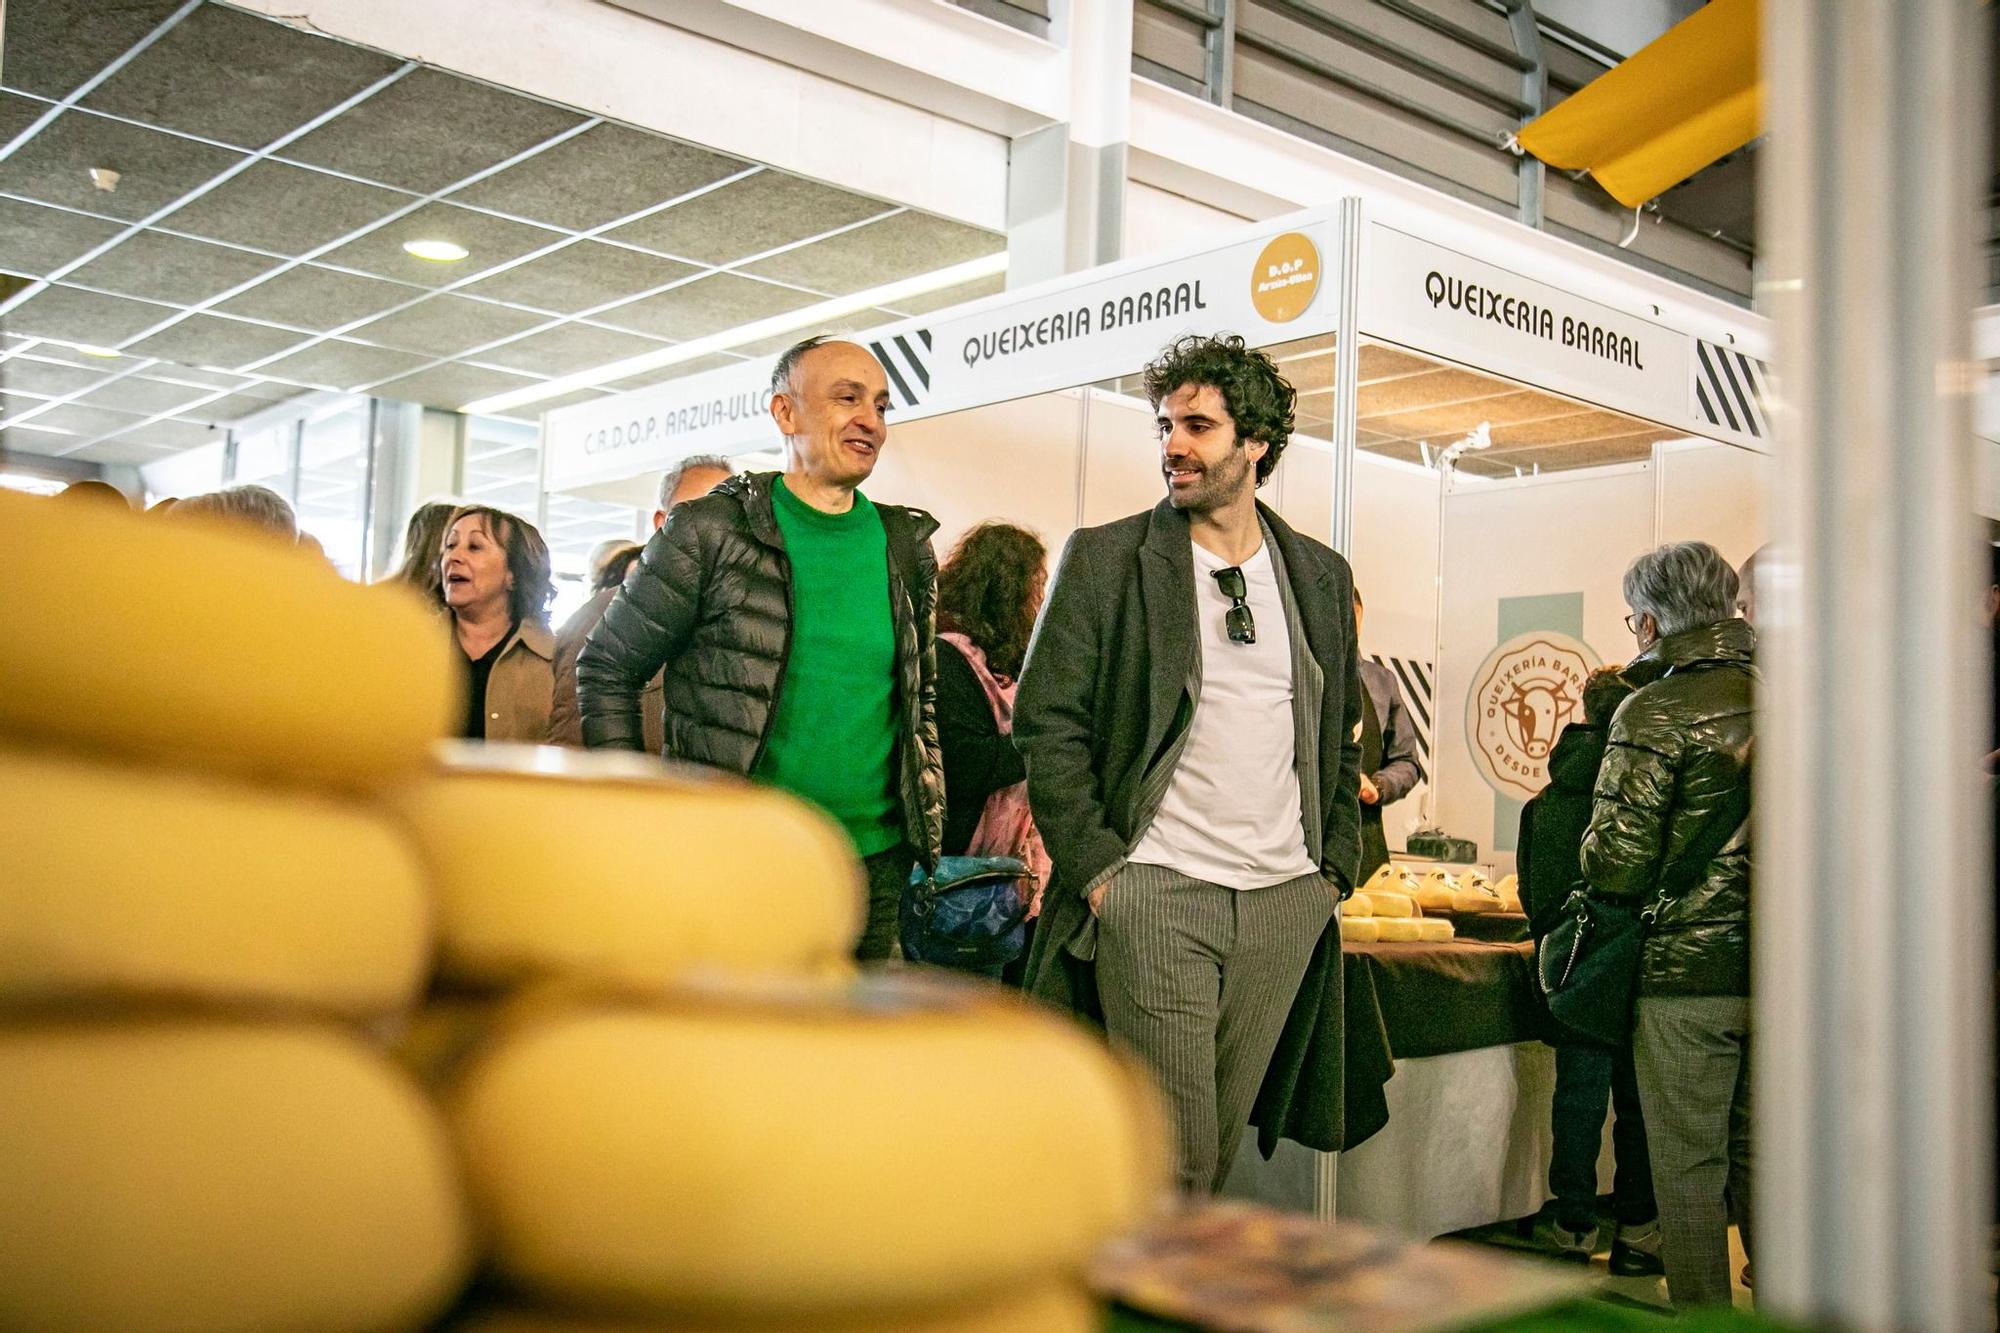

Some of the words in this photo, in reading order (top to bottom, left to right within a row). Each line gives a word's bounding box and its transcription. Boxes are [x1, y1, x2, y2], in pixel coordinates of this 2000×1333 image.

[963, 307, 1091, 369] QUEIXERIA
[1100, 280, 1206, 332] BARRAL
[1425, 271, 1553, 340] QUEIXERIA
[1562, 316, 1643, 370] BARRAL
[665, 387, 773, 437] ARZUA-ULLO
[1487, 655, 1546, 718] QUEIXERÍA
[1553, 659, 1585, 695] BARR
[1495, 744, 1541, 778] DESDE
